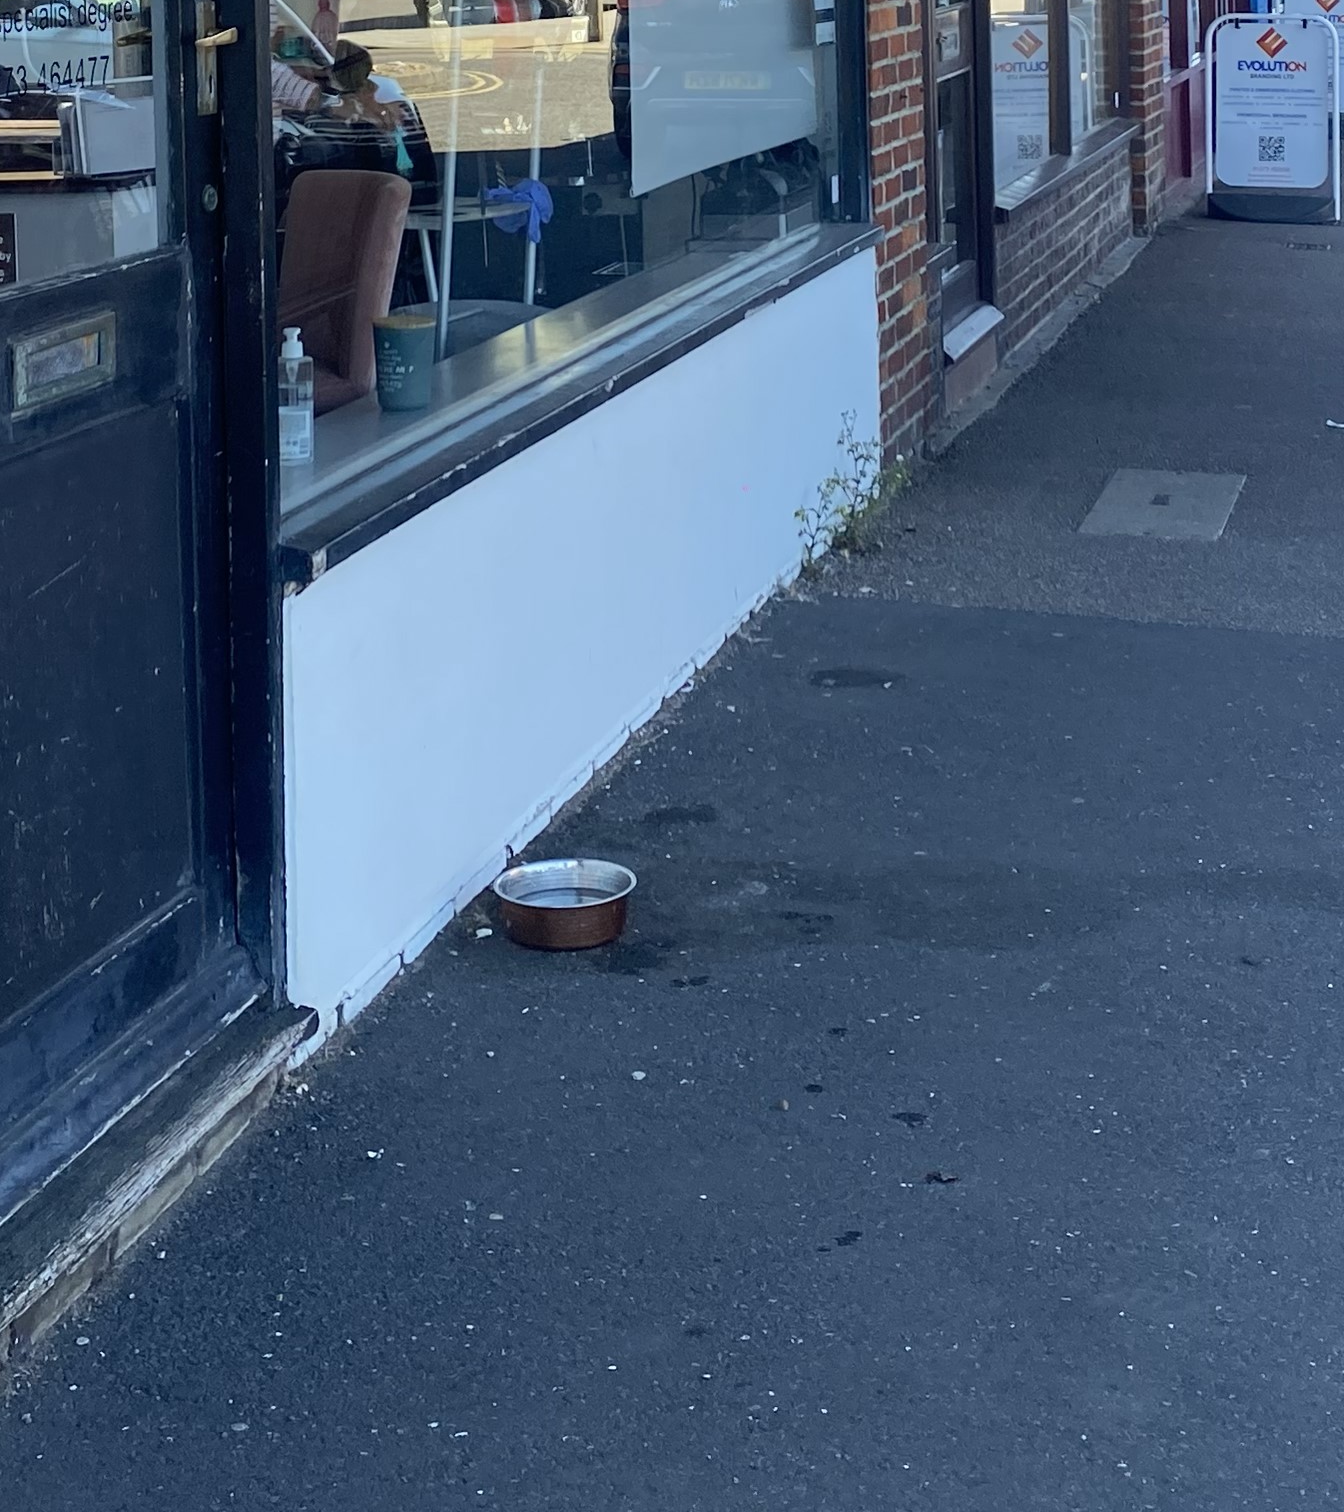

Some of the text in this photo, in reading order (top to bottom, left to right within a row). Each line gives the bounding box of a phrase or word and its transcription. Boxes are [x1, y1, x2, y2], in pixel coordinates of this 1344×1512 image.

[1237, 60, 1307, 72] EVOLUTION
[37, 55, 110, 96] 464477
[0, 250, 12, 263] by
